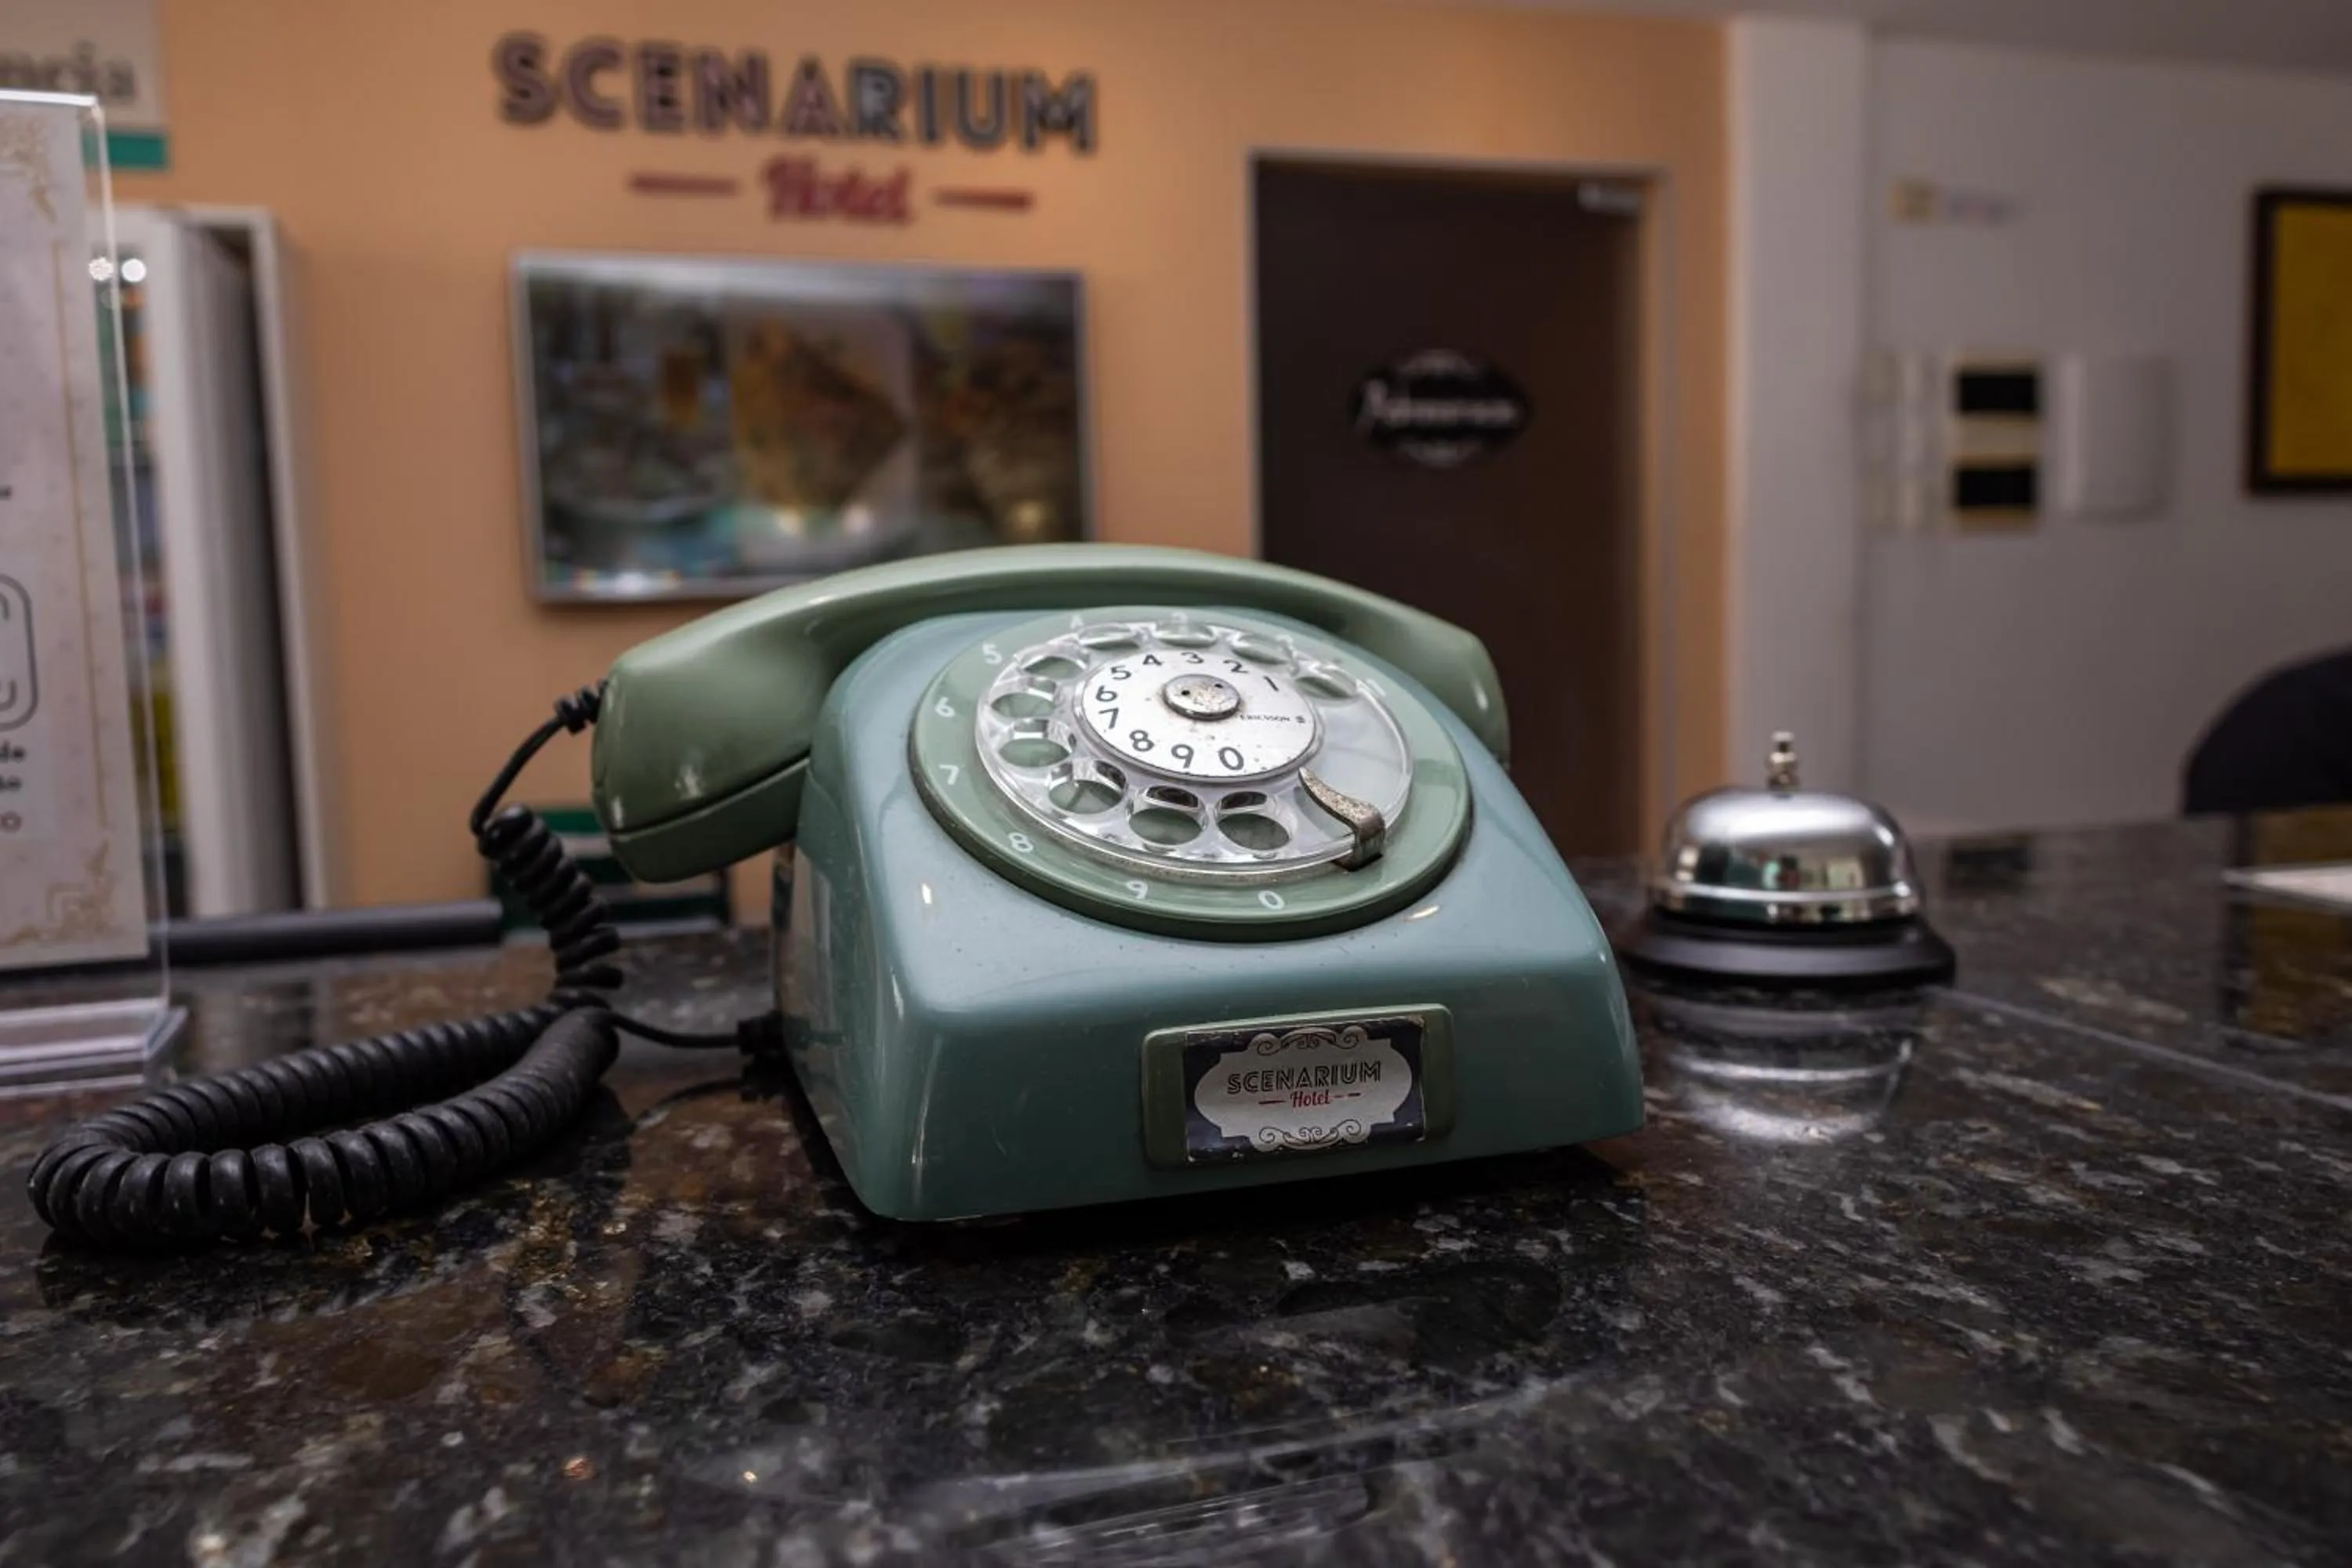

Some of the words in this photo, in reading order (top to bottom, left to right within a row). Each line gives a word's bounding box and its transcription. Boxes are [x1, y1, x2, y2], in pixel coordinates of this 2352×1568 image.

[494, 33, 1098, 154] SCENARIUM
[1142, 654, 1163, 667] 4
[1181, 652, 1205, 664] 3
[1223, 659, 1250, 673] 2
[1111, 666, 1131, 680] 5
[1094, 685, 1118, 702] 6
[1263, 675, 1279, 692] 1
[935, 697, 955, 717] 6
[1098, 707, 1119, 730] 7
[1129, 730, 1154, 752] 8
[1171, 744, 1194, 769] 9
[1218, 746, 1244, 771] 0
[938, 764, 960, 785] 7
[1007, 832, 1034, 853] 8
[1126, 880, 1149, 900] 9
[1258, 889, 1286, 909] 0
[1227, 1060, 1381, 1094] SCENARIUM
[1289, 1091, 1331, 1109] Hotel
